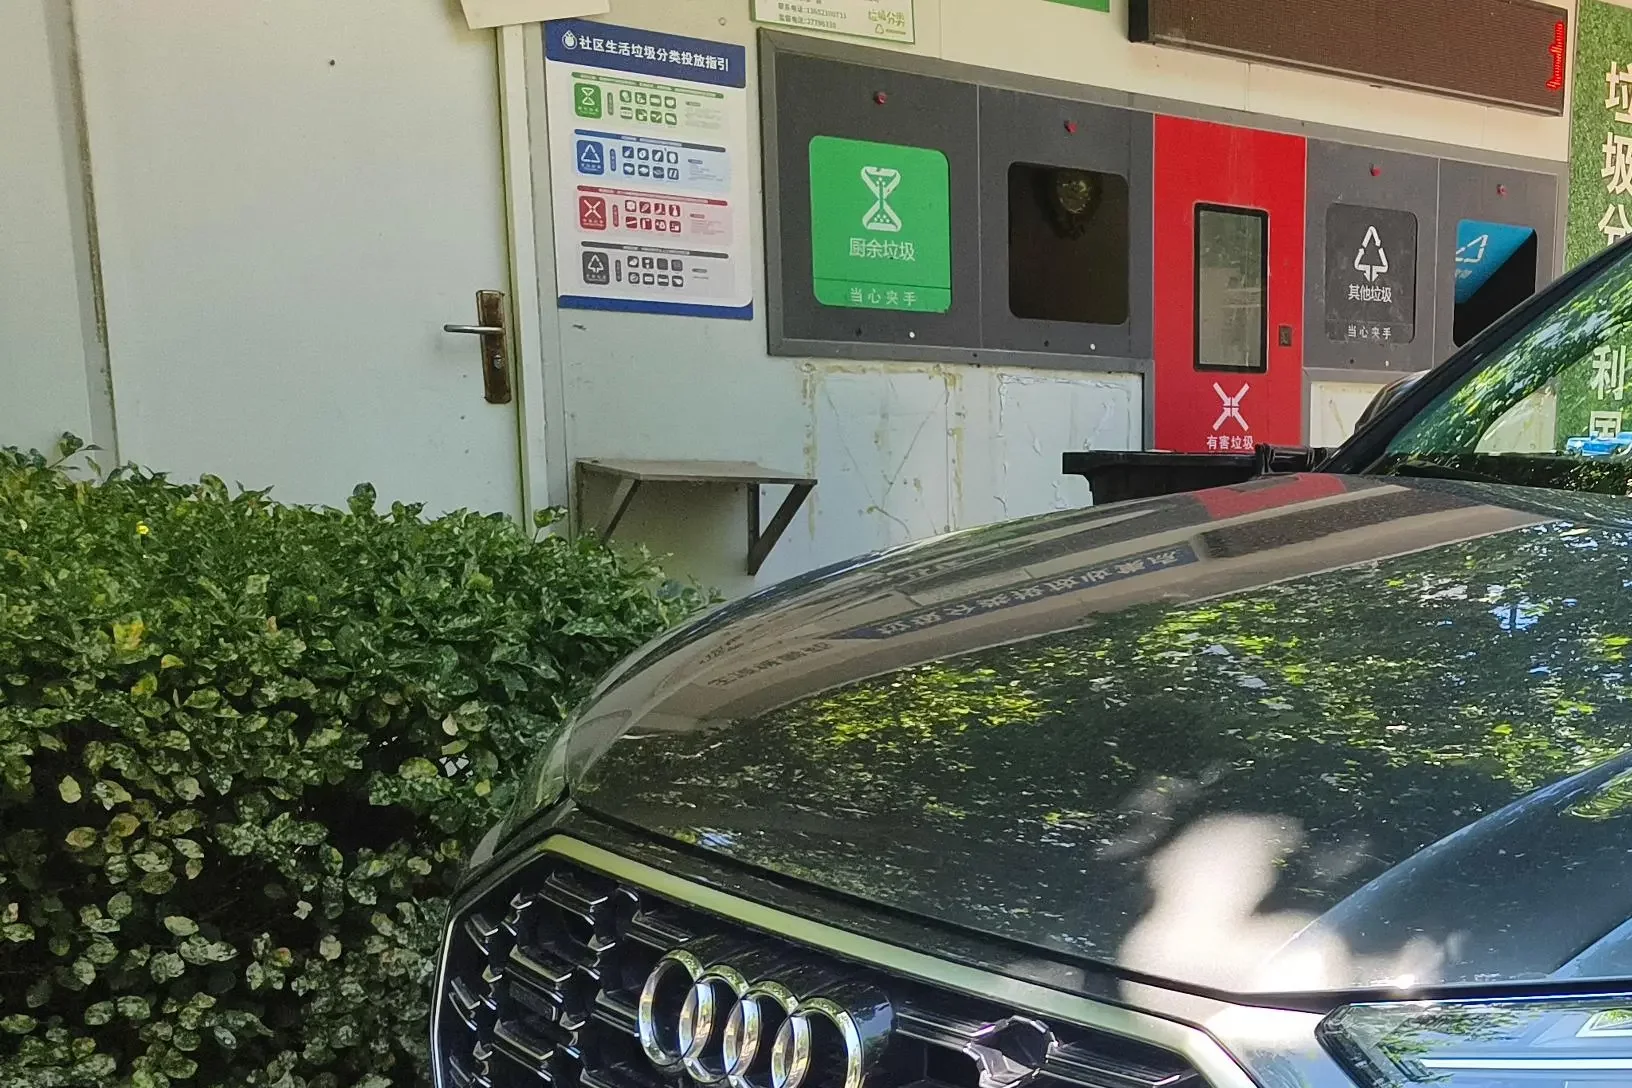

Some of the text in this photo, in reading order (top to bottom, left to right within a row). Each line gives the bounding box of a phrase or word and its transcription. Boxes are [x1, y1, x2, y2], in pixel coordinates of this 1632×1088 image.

[579, 35, 729, 72] 社区生活垃圾分类投放指引
[849, 237, 915, 261] 厨余垃圾
[850, 287, 917, 306] 当心夹手
[1348, 284, 1392, 303] 其他垃圾
[1347, 324, 1392, 340] 当心夹手
[1206, 435, 1254, 450] 有害垃圾
